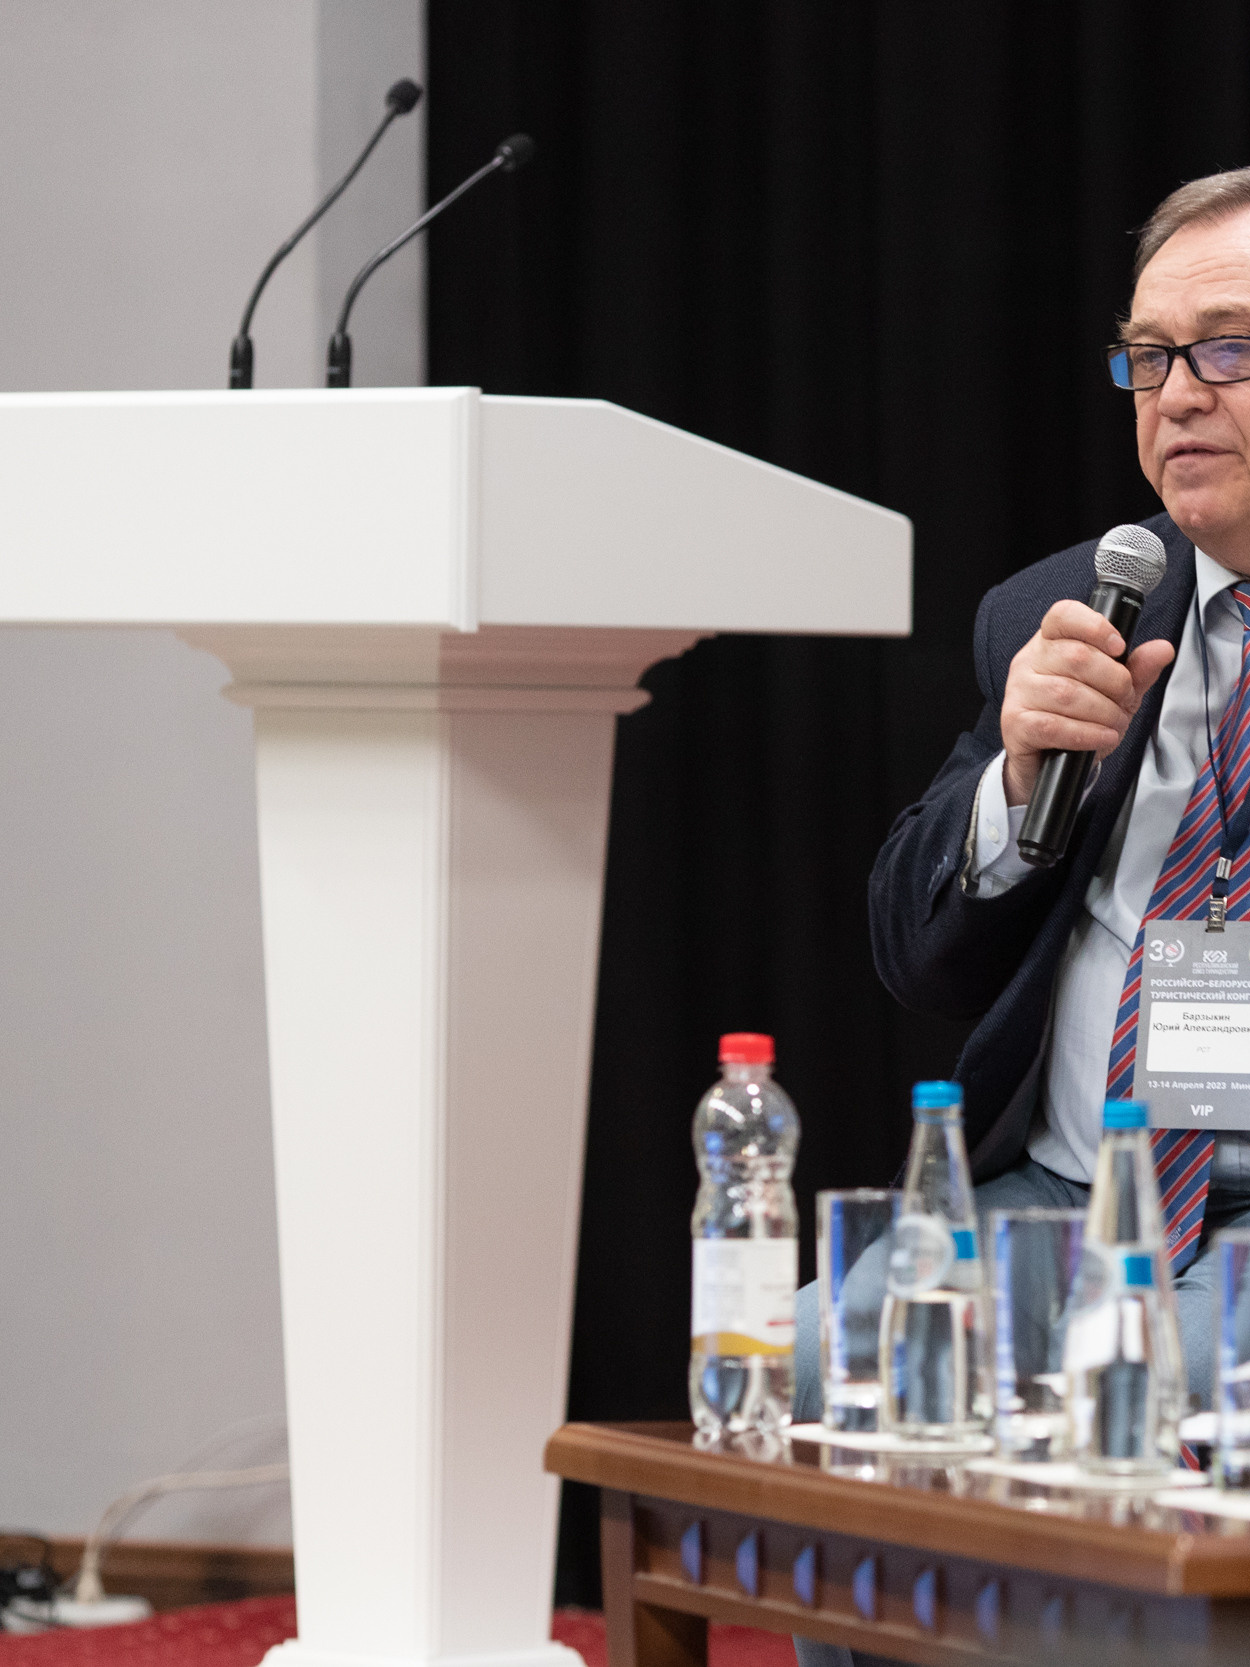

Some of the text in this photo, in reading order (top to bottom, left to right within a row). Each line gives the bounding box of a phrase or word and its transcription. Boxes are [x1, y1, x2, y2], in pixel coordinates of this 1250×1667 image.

[1150, 990, 1226, 1001] ТУРИСТИЧЕСКИЙ
[1182, 1012, 1231, 1021] Барзыкин
[1152, 1022, 1180, 1033] Юрий
[1148, 1080, 1170, 1089] 13-14
[1172, 1081, 1204, 1091] Апреля
[1206, 1081, 1227, 1090] 2023
[1190, 1104, 1214, 1116] VIP
